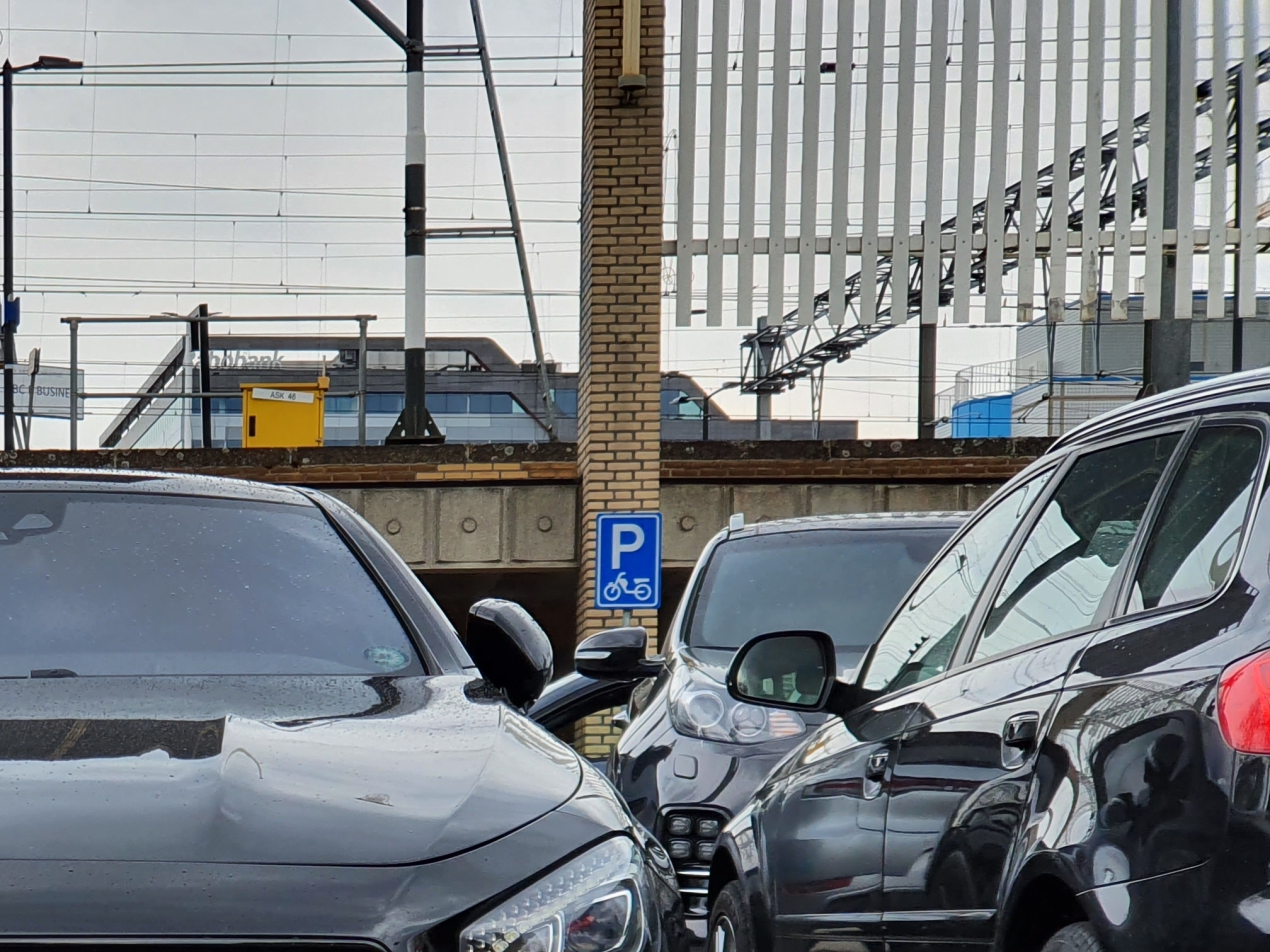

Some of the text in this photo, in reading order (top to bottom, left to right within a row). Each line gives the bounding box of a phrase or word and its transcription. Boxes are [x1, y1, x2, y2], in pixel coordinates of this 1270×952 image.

[36, 385, 71, 398] BUSINE
[270, 391, 285, 399] ASK
[612, 523, 645, 570] P
